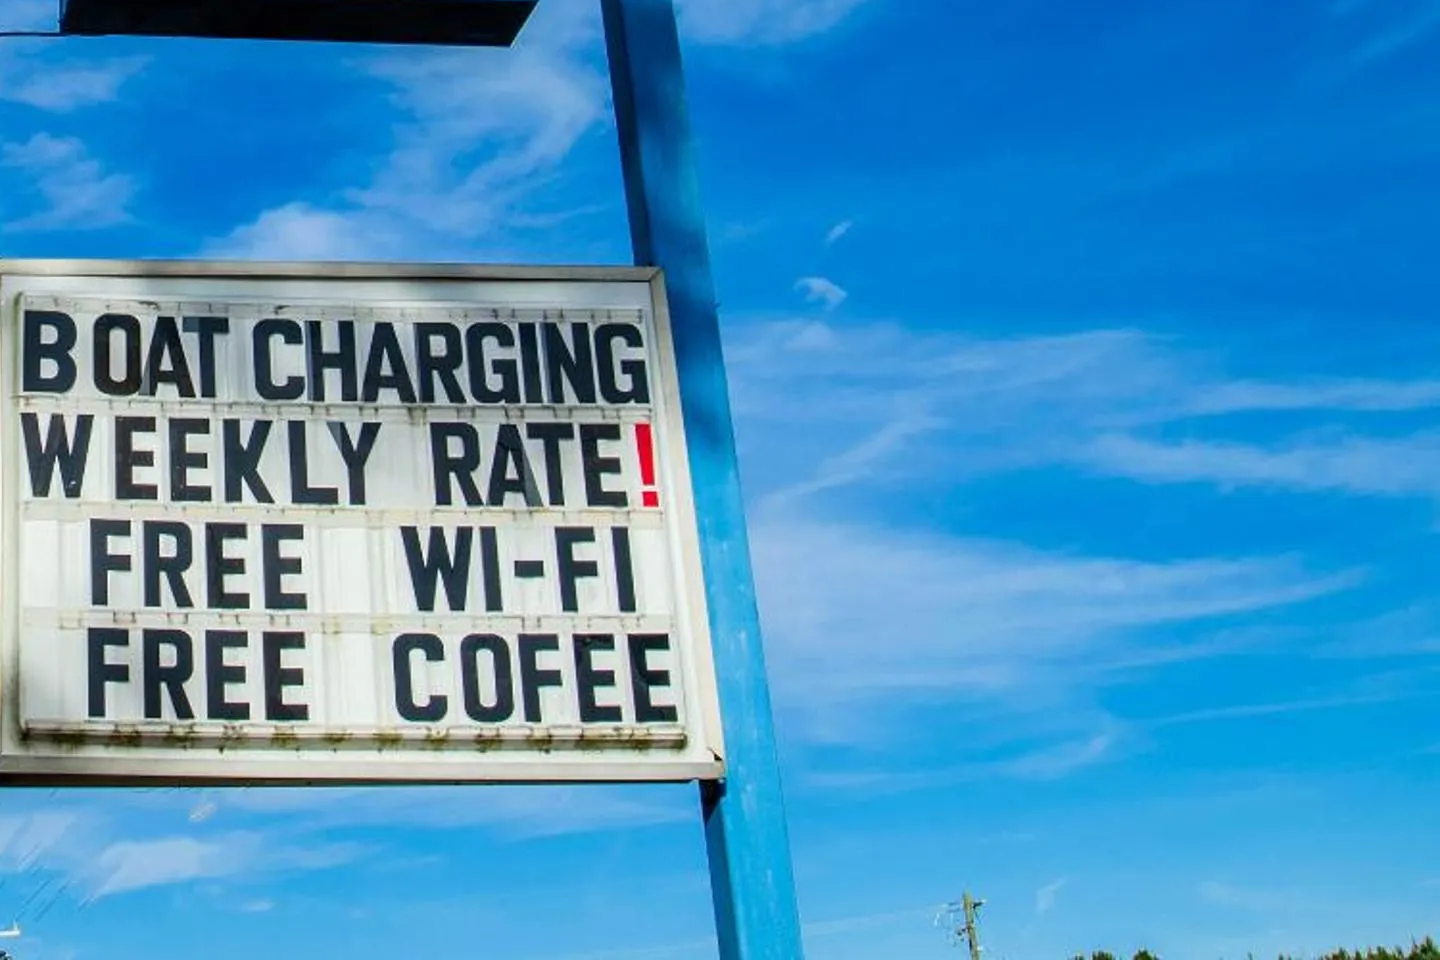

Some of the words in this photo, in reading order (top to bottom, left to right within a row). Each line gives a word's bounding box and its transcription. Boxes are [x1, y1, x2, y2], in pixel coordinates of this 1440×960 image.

[22, 310, 228, 398] BOAT
[252, 318, 649, 404] CHARGING
[21, 412, 381, 506] WEEKLY
[429, 421, 658, 508] RATE!
[89, 519, 307, 610] FREE
[401, 526, 636, 613] WI-FI
[87, 627, 308, 721] FREE
[392, 632, 678, 723] COFEE
